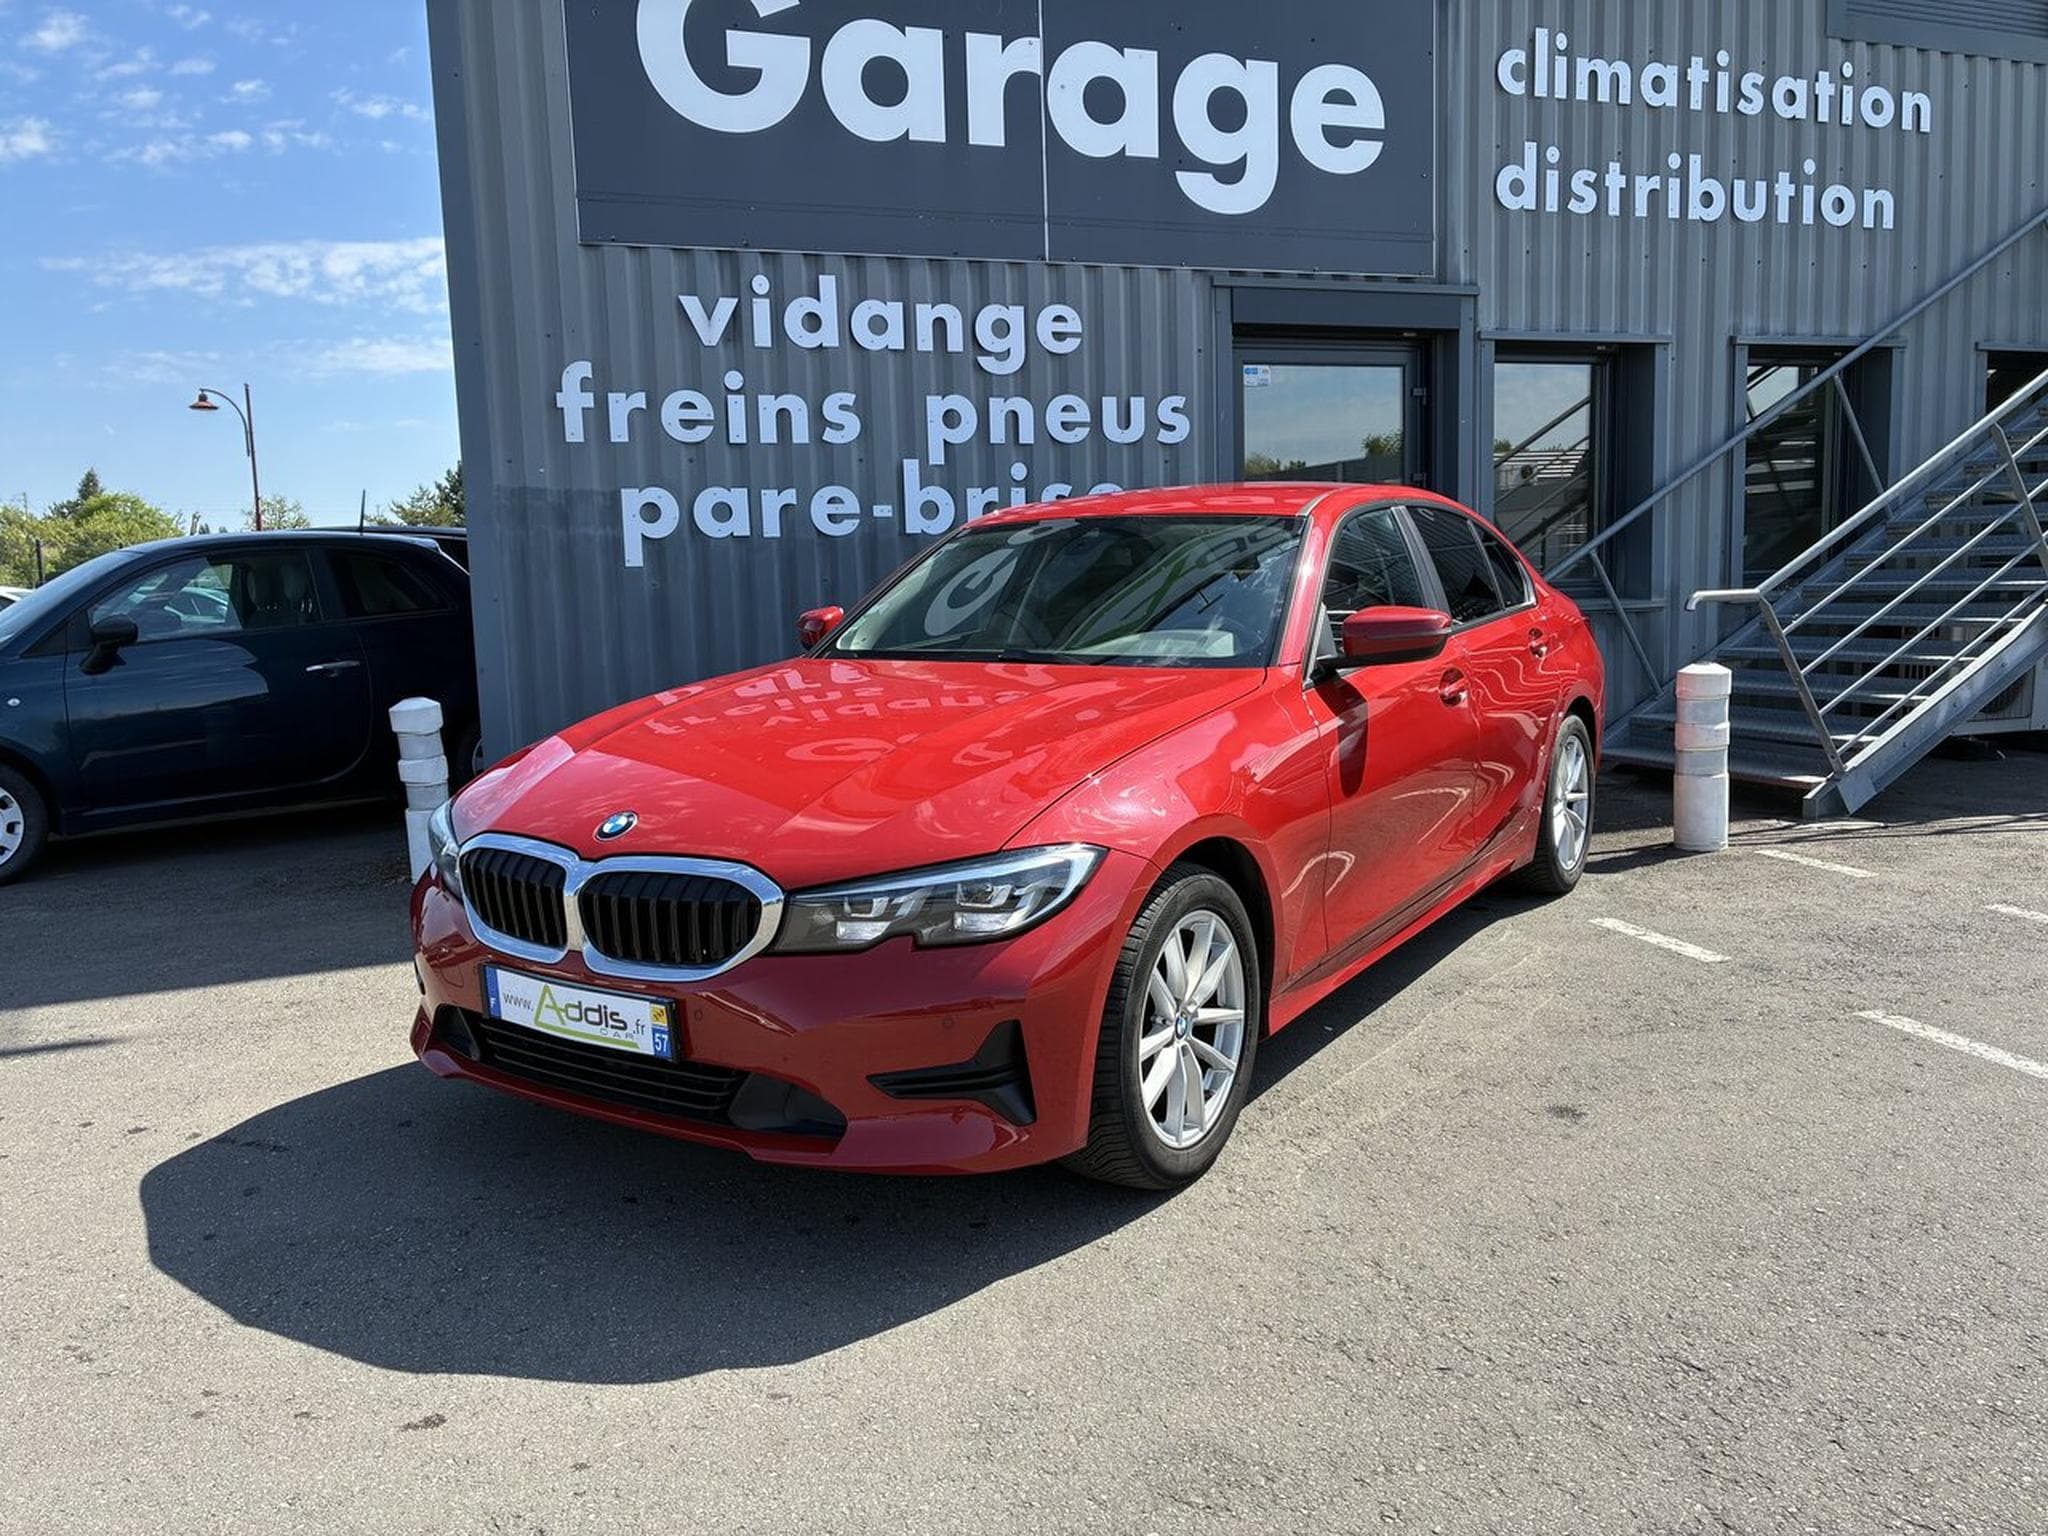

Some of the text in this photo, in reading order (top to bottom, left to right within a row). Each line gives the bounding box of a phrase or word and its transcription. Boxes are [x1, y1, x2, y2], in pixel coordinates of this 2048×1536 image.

[636, 0, 1385, 215] Garage
[1496, 26, 1932, 134] climatisation
[1495, 141, 1895, 230] distribution
[677, 273, 1083, 375] vidange
[556, 360, 1191, 466] freins pneus
[620, 458, 1124, 568] pare-bri
[654, 1032, 669, 1053] 57
